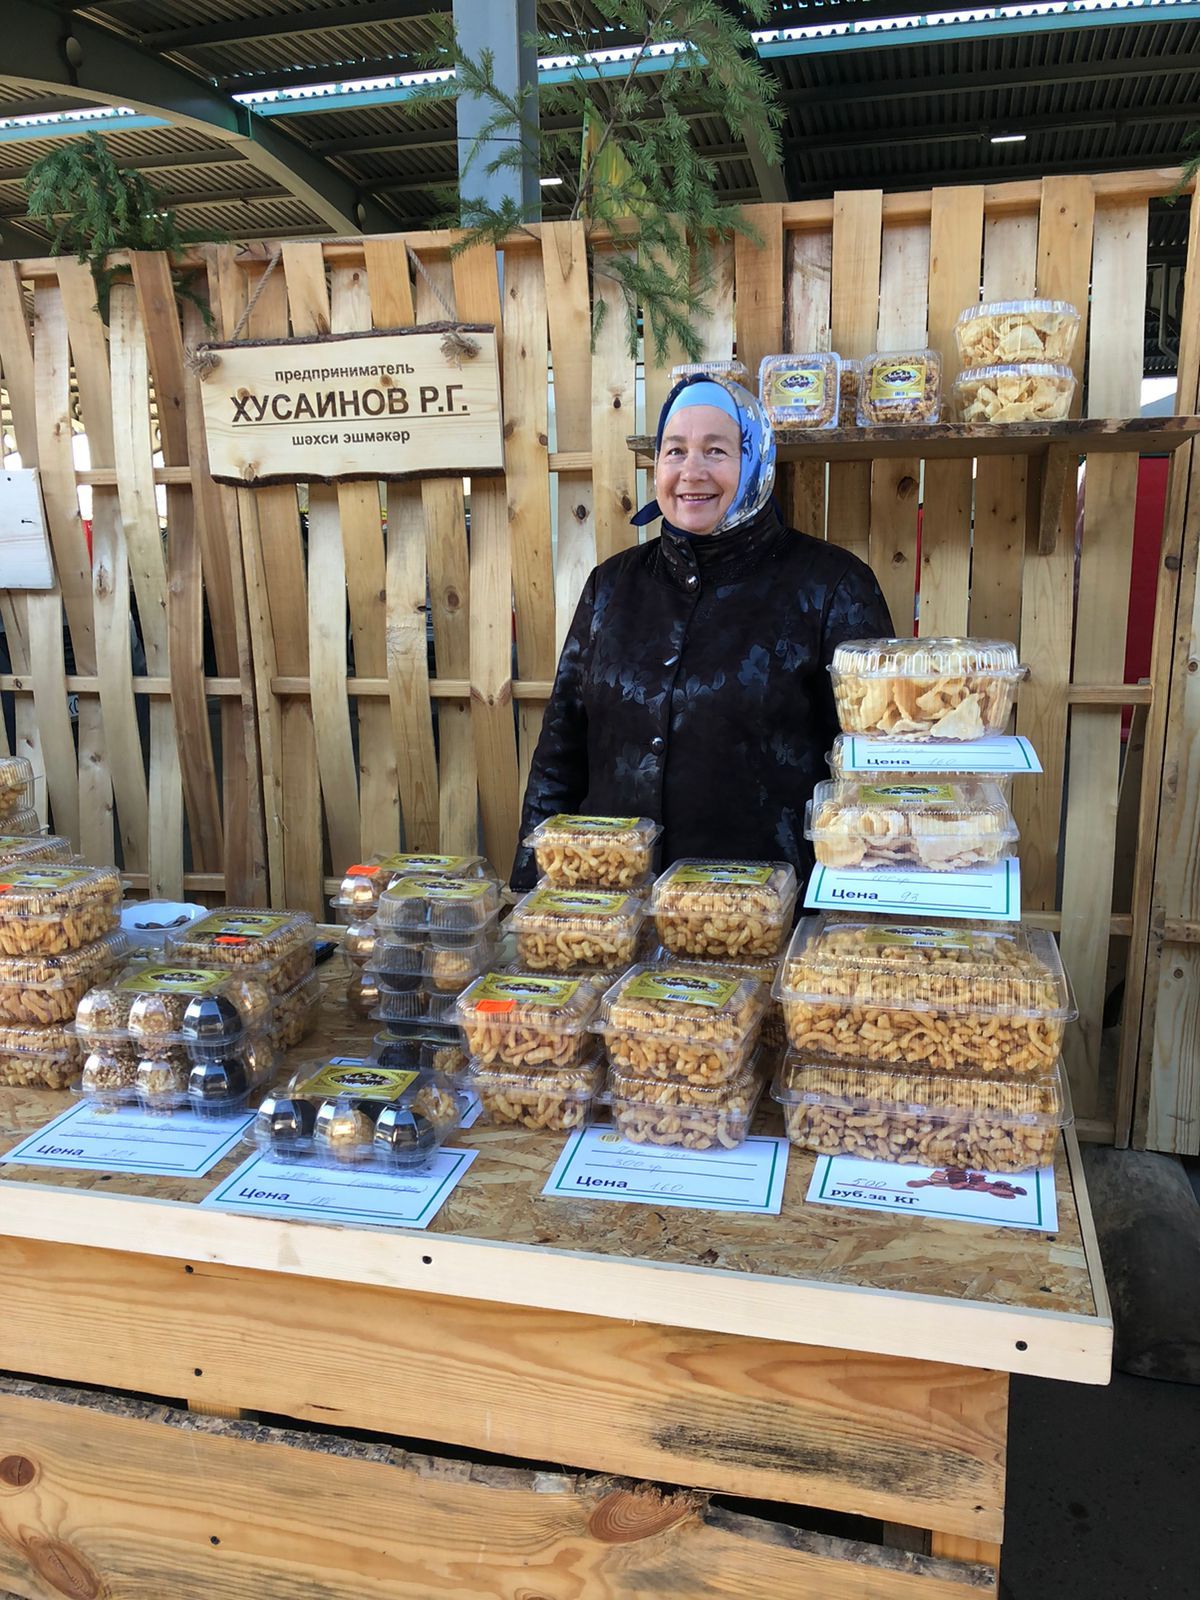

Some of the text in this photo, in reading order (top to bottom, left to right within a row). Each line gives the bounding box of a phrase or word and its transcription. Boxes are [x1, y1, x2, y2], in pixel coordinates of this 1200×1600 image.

[275, 362, 415, 384] предприниматель
[231, 384, 468, 422] ХУСАИНОВ Р.Г.
[292, 429, 410, 446] шәхси эшмәкәр
[866, 758, 911, 766] Цена
[831, 888, 878, 900] Цена
[36, 1144, 85, 1156] Цена
[576, 1176, 628, 1189] Цена
[239, 1187, 290, 1201] Цена
